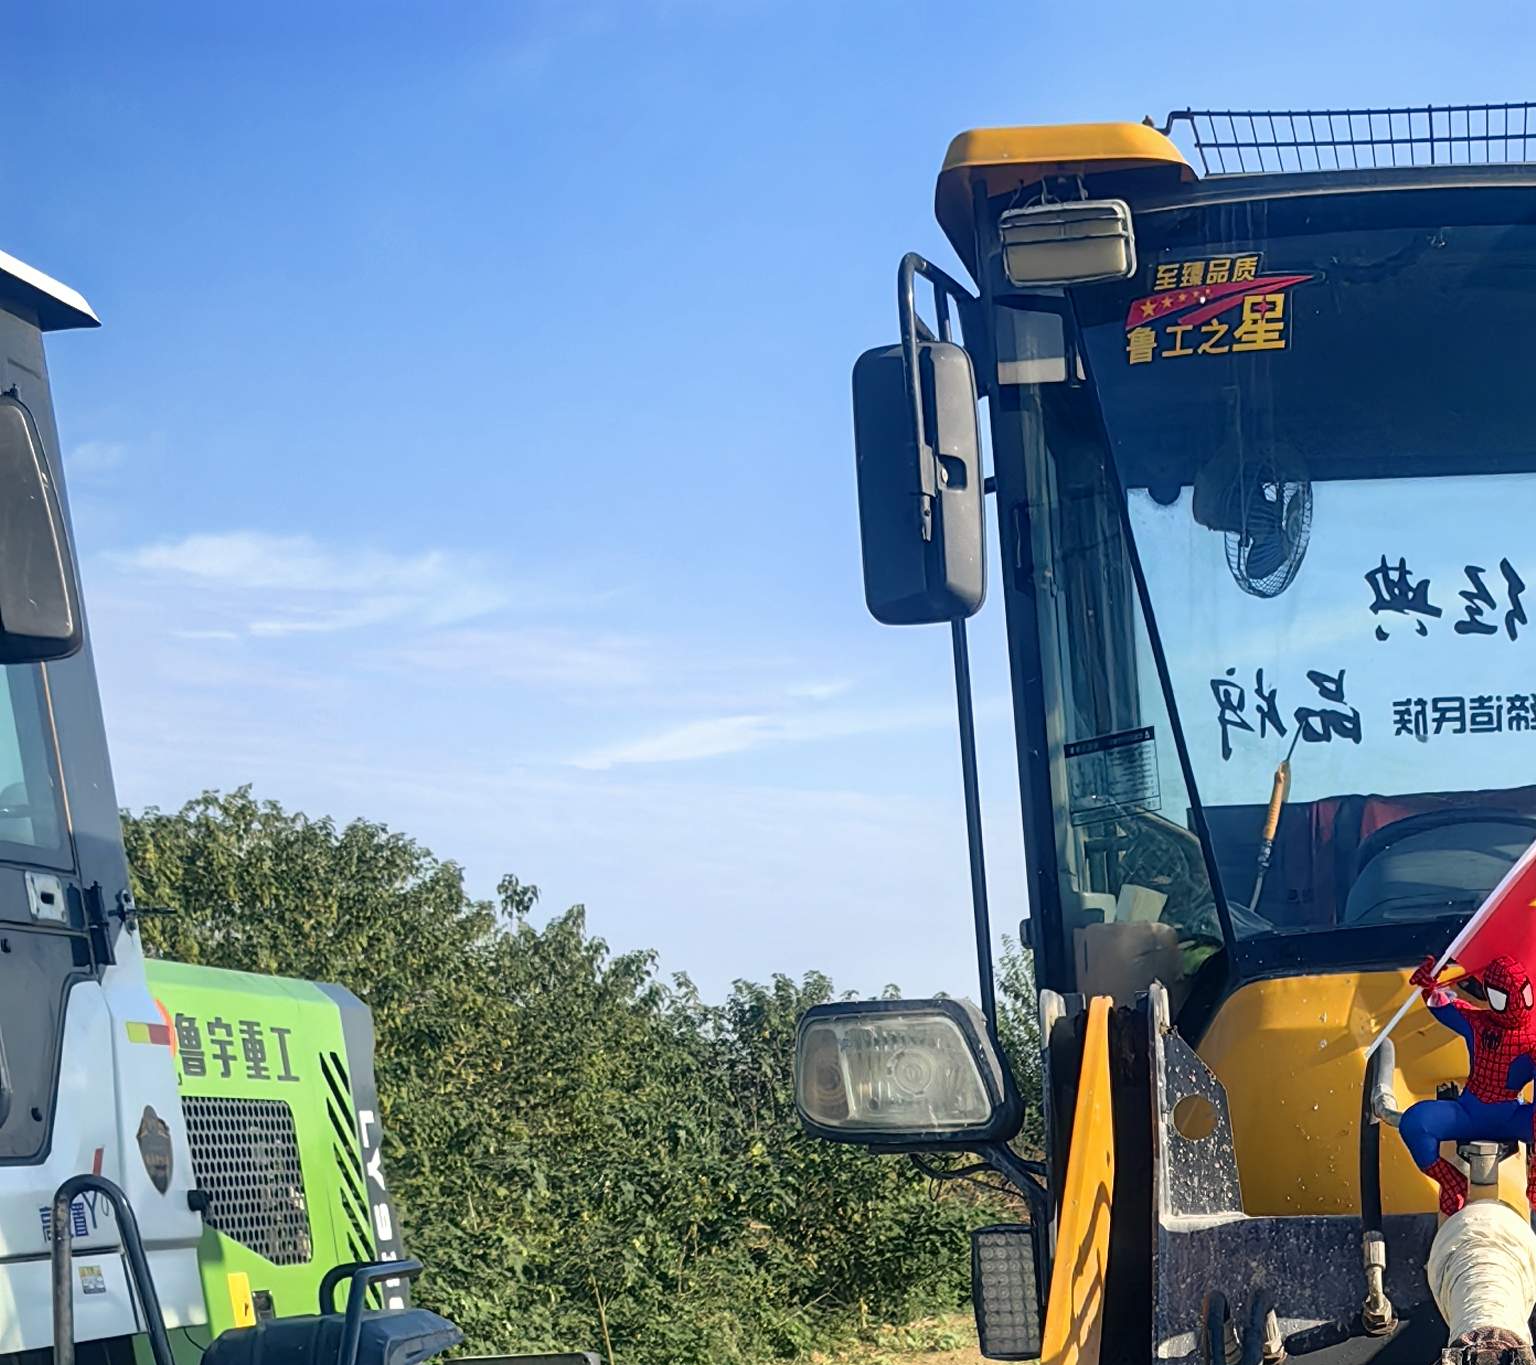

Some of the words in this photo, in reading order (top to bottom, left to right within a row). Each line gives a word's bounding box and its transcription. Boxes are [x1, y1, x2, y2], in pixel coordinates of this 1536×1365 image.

[1153, 255, 1259, 291] 至臻品质
[1126, 292, 1286, 365] 鲁工之星
[175, 1013, 300, 1082] 鲁宇重工
